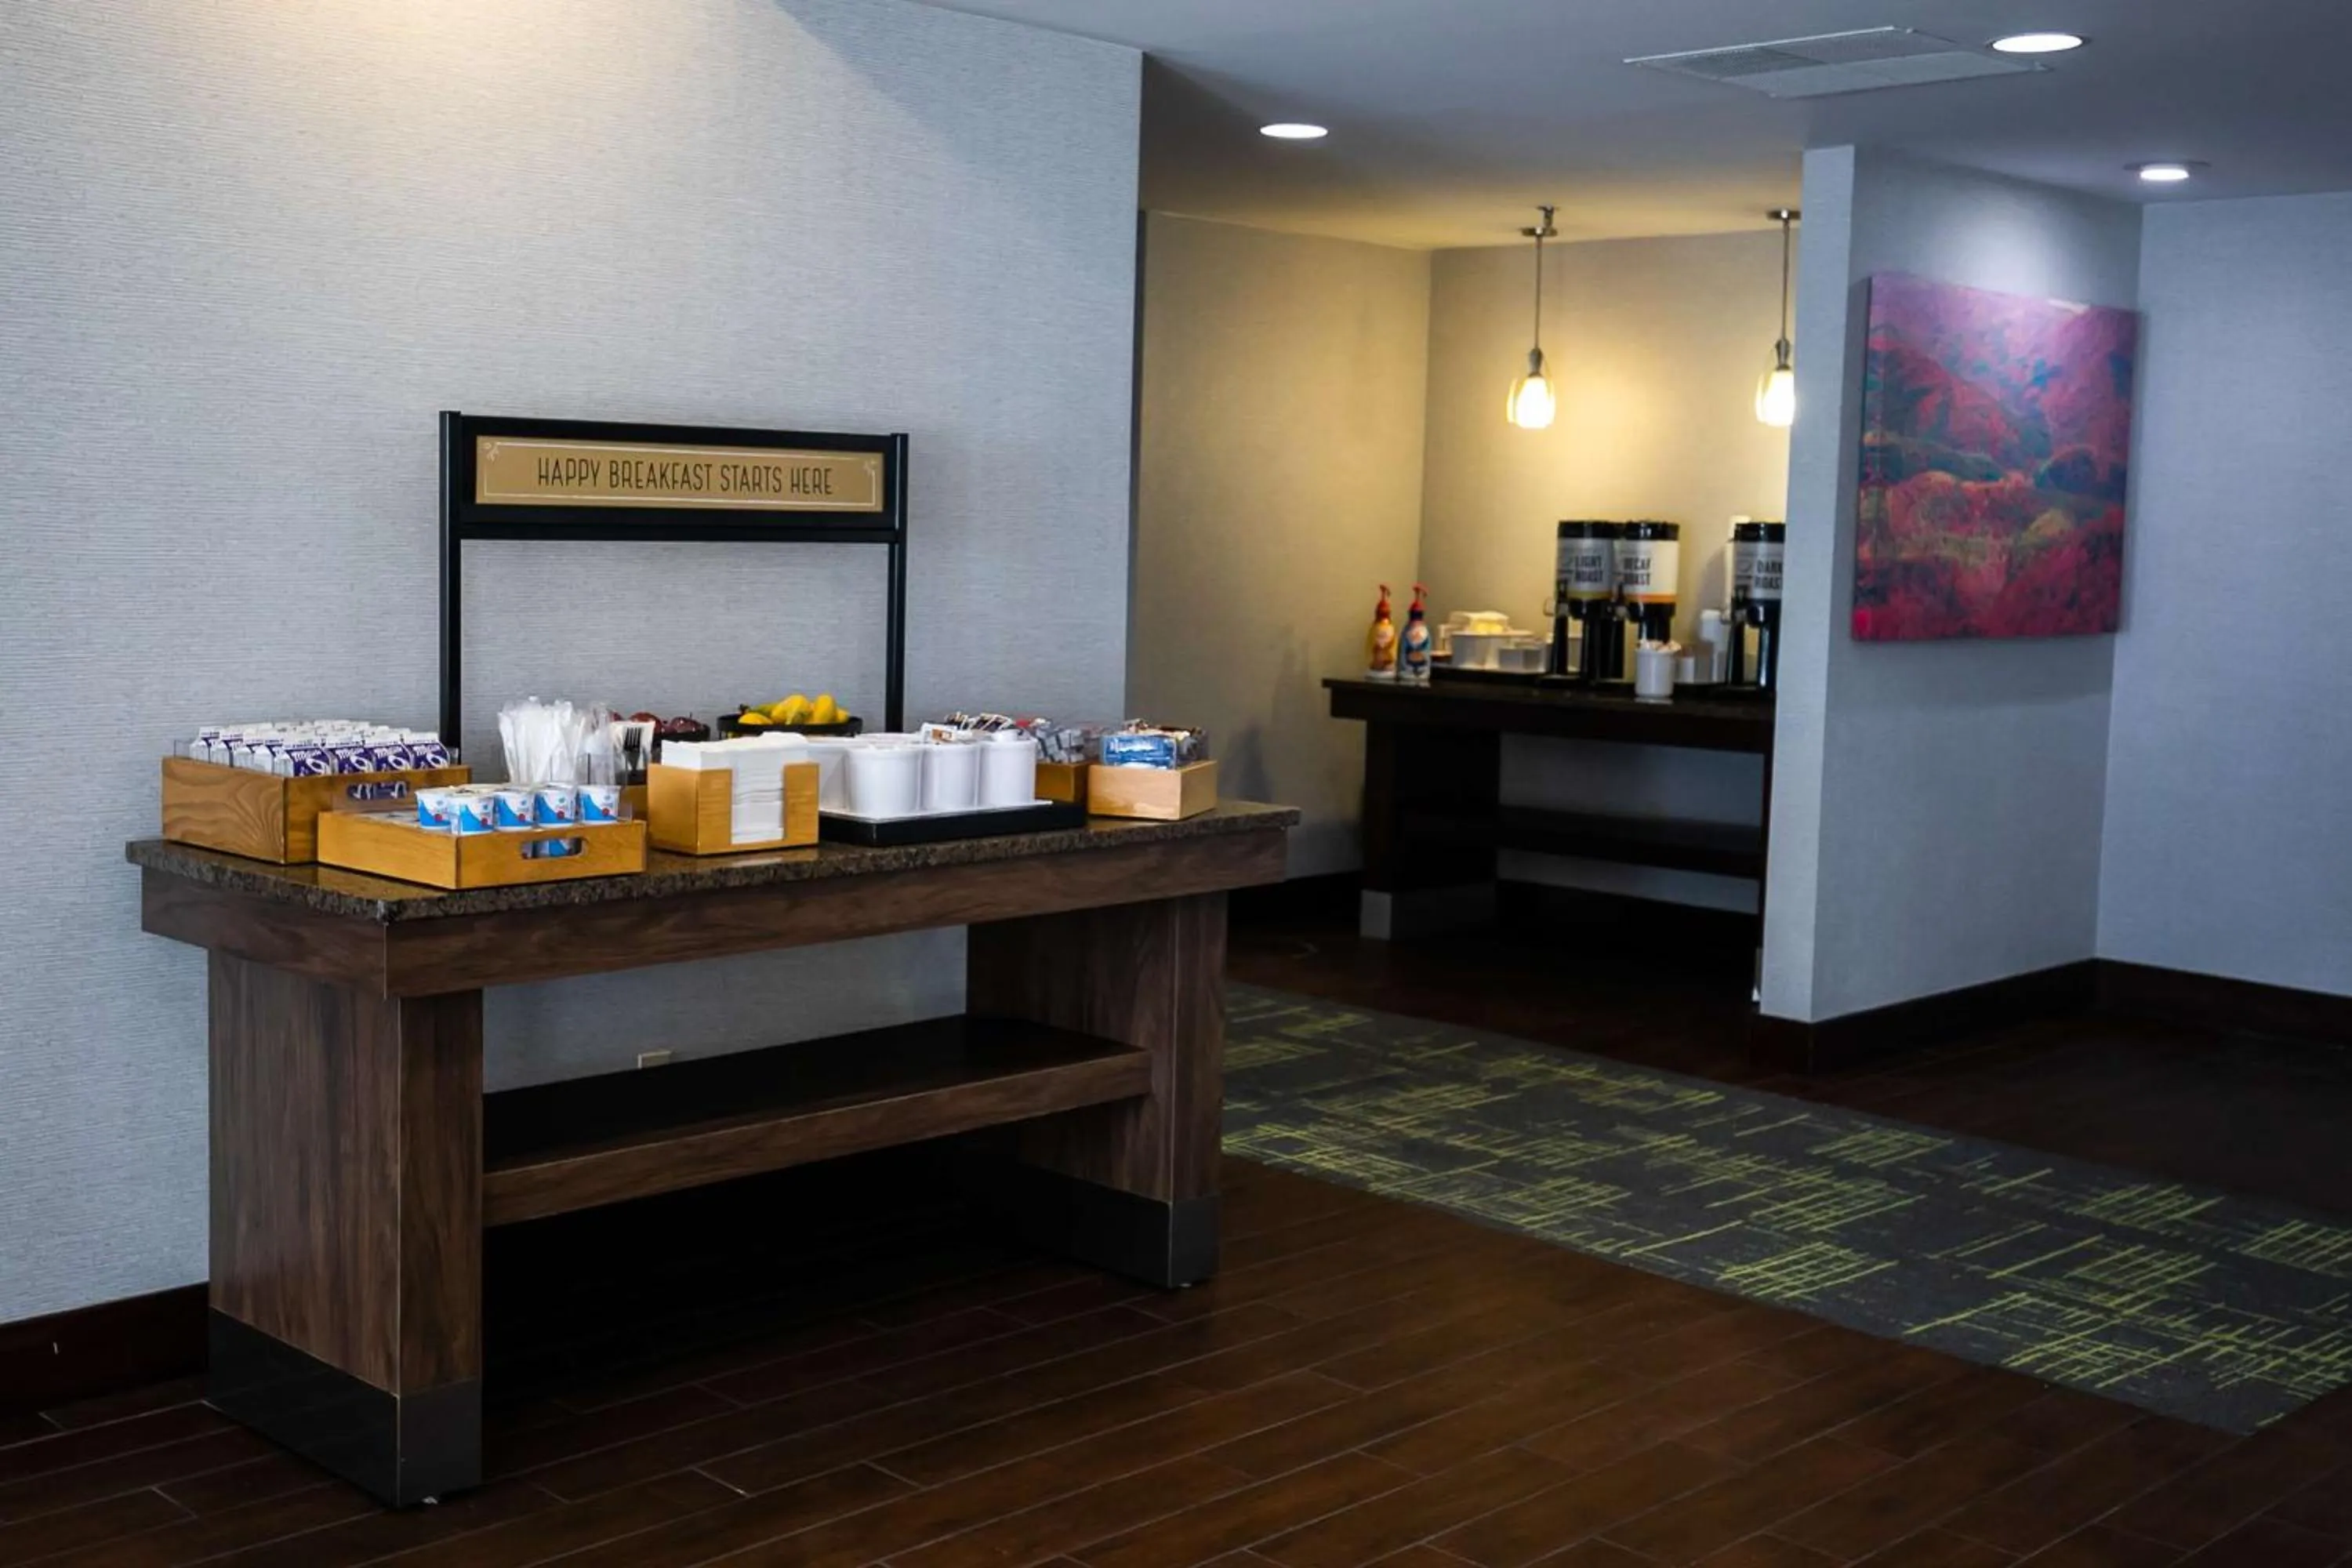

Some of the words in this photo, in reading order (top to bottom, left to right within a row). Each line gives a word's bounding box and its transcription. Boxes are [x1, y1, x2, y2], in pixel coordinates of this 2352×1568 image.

[538, 457, 601, 488] HAPPY
[608, 459, 713, 492] BREAKFAST
[720, 464, 782, 493] STARTS
[790, 467, 833, 495] HERE
